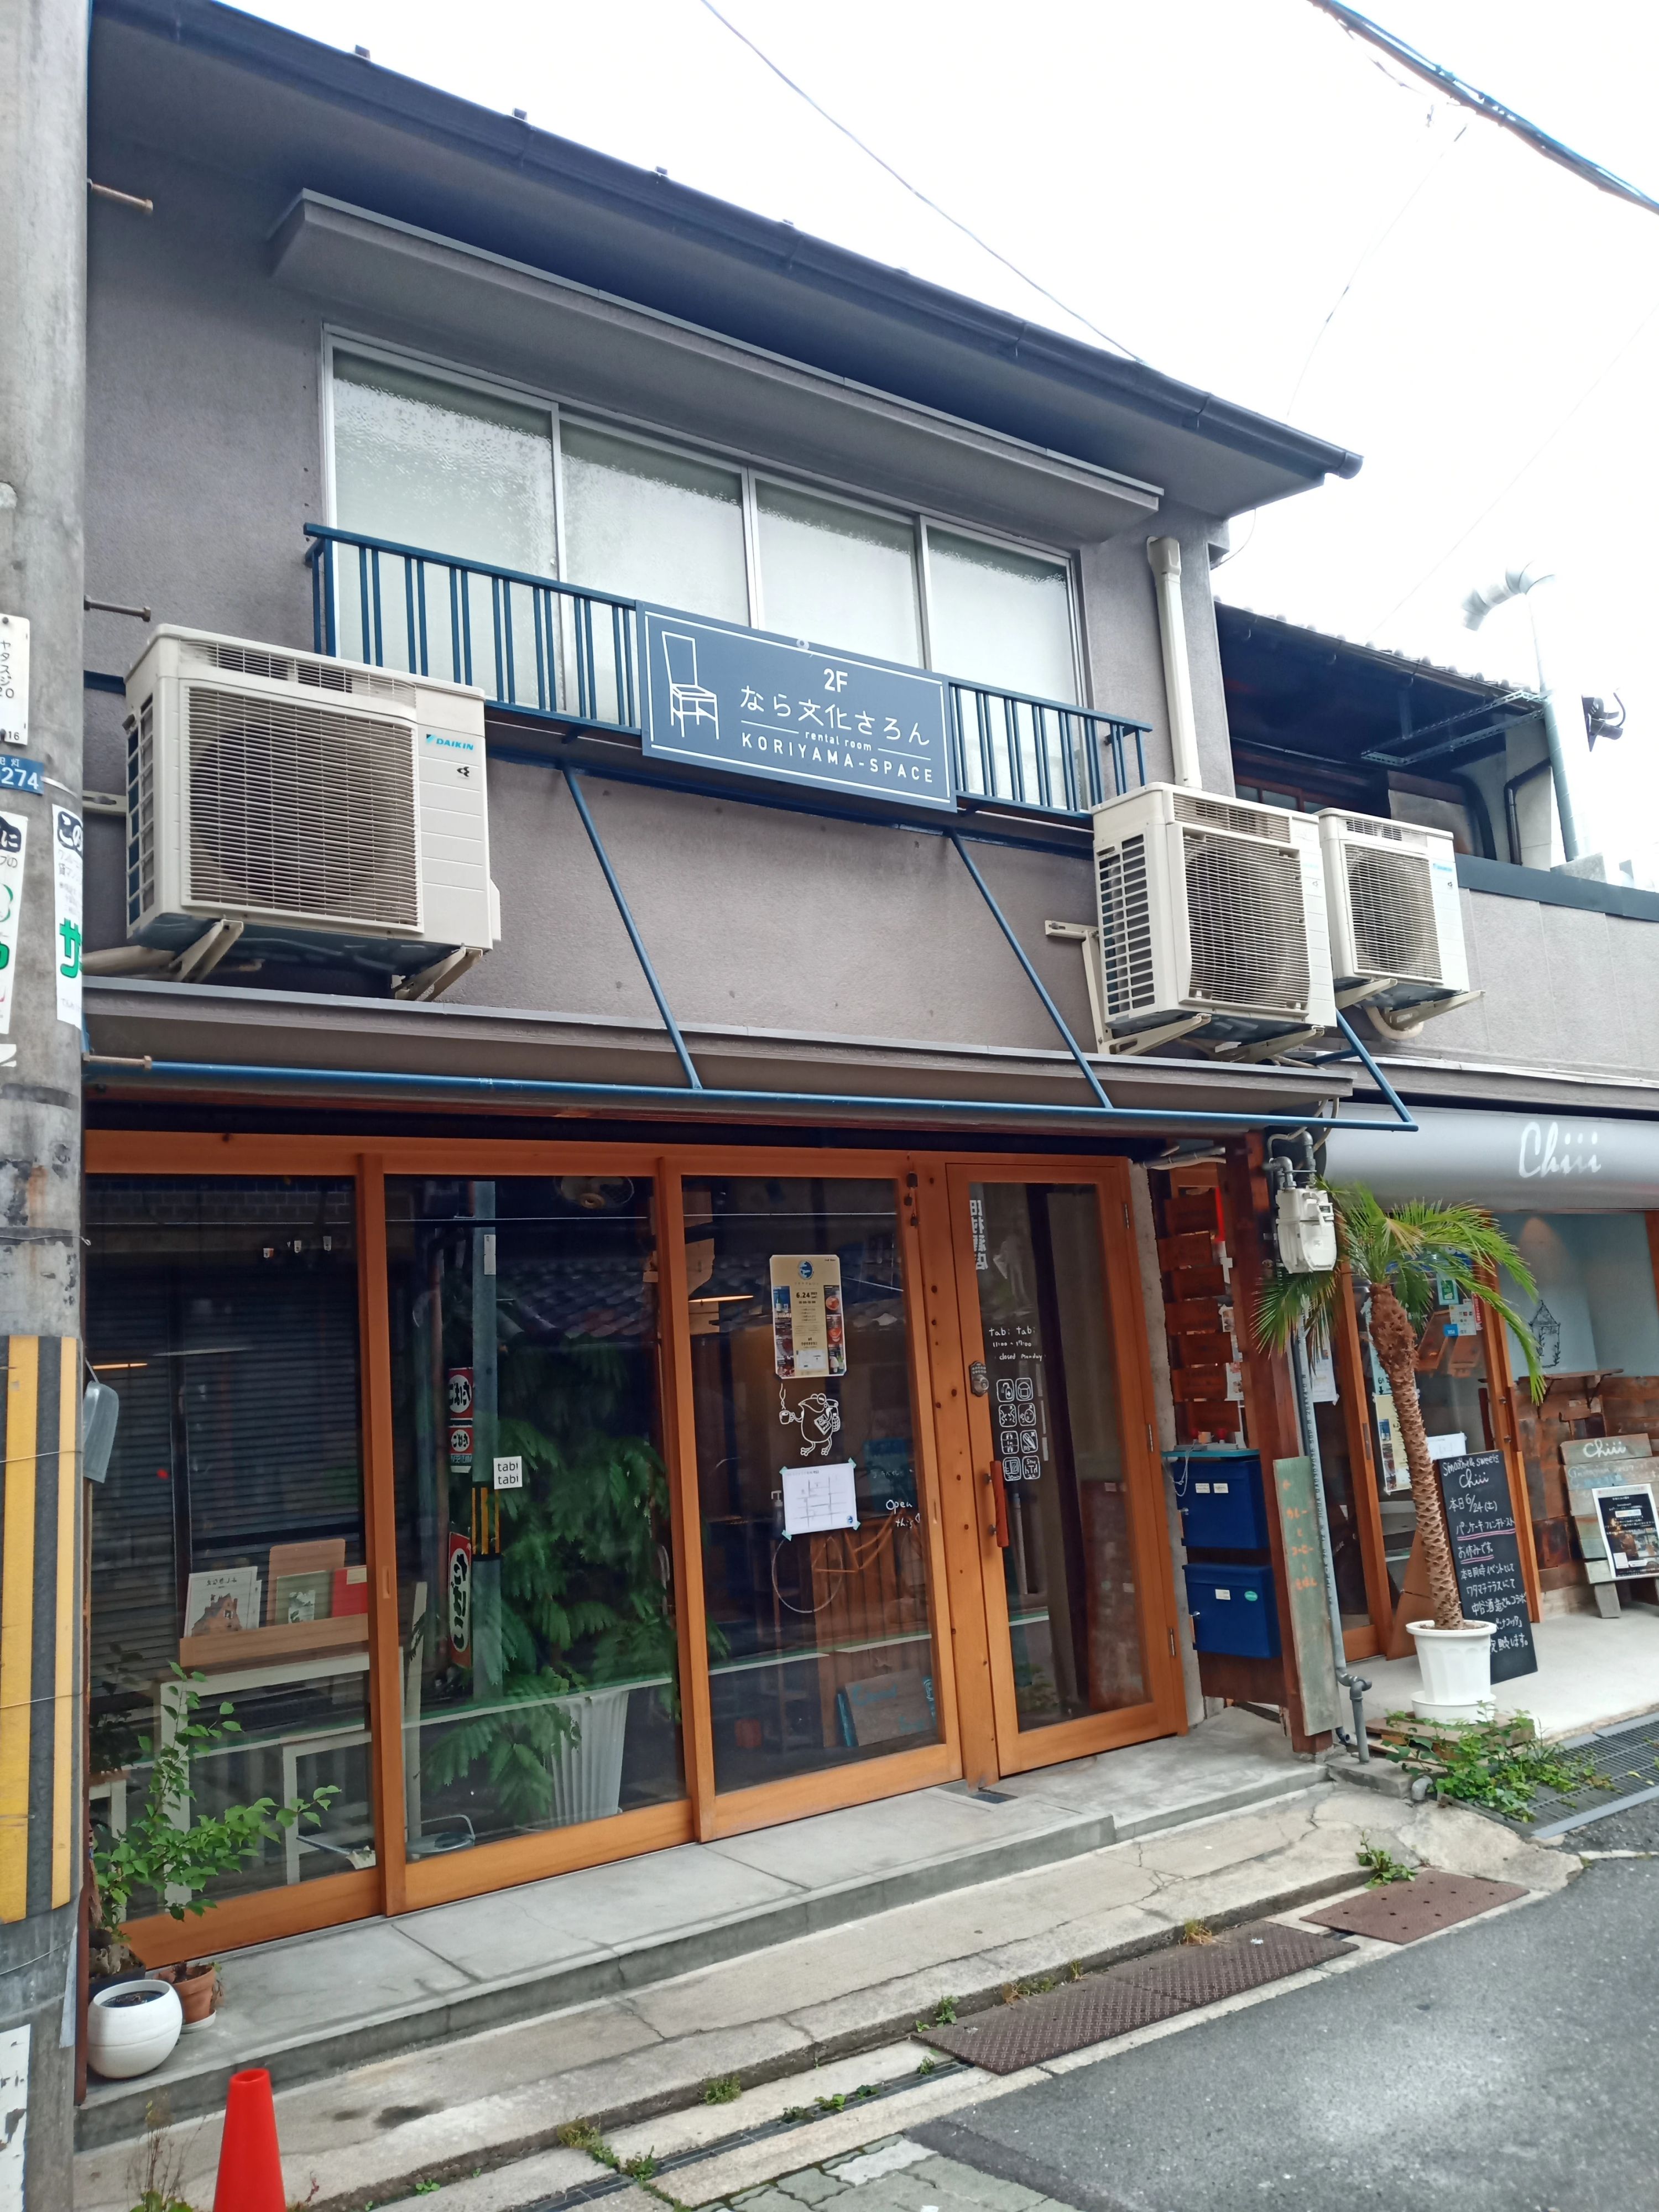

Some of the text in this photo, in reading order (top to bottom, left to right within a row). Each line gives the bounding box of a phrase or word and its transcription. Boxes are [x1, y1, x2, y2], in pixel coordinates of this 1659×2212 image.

[823, 669, 848, 693] 2F
[740, 685, 930, 745] なら文化さろん
[8, 731, 20, 740] 16
[805, 730, 872, 751] rental room
[436, 738, 474, 751] DAIKIN
[742, 732, 933, 784] KORIYAMA-SPACE
[1519, 1121, 1601, 1178] Chiii
[989, 1325, 1036, 1336] tabi tabi
[1021, 1353, 1042, 1361] Monday
[1582, 1439, 1627, 1458] Chiii
[497, 1462, 518, 1472] tabi
[498, 1475, 519, 1485] tabi
[1459, 1468, 1489, 1488] Chiii
[885, 1499, 913, 1515] Open
[895, 1517, 914, 1531] this
